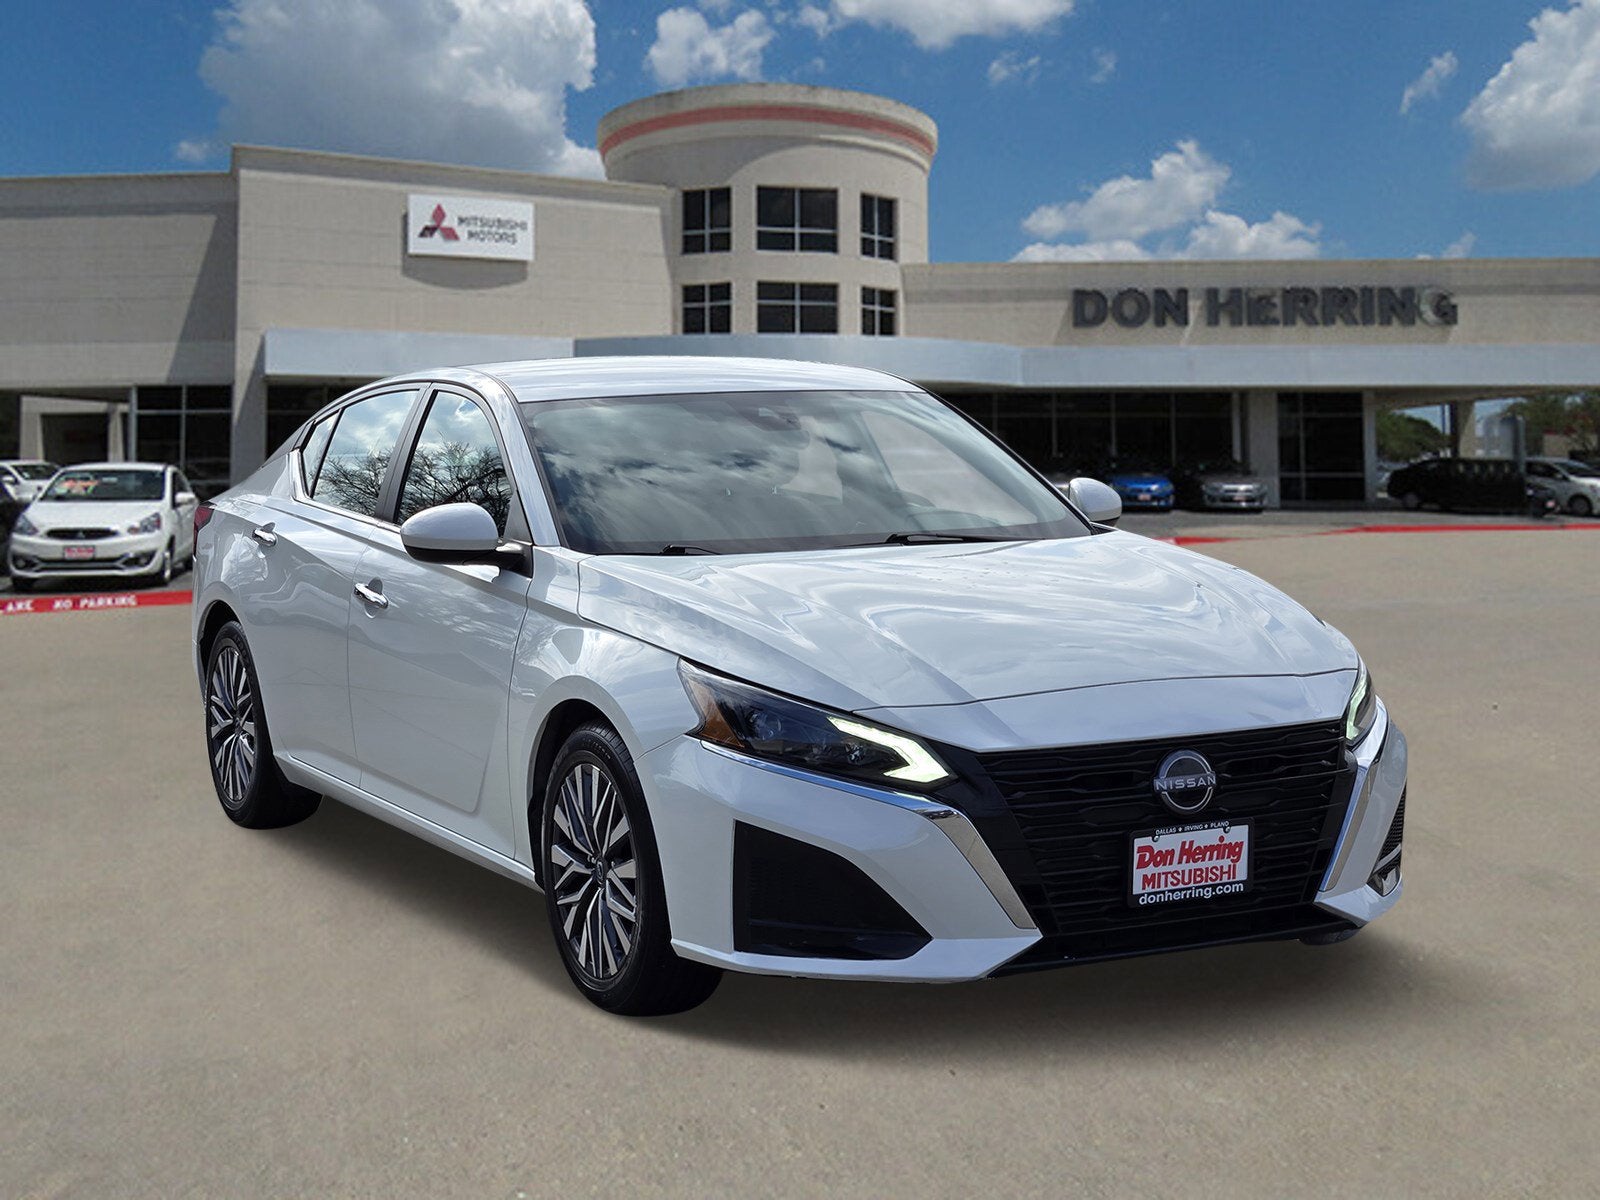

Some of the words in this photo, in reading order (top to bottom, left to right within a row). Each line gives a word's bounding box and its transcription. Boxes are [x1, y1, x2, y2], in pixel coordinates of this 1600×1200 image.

[458, 216, 528, 231] MITSUBISHI
[468, 230, 517, 244] MOTORS
[1072, 288, 1189, 328] DON
[1205, 286, 1459, 328] HERRING
[79, 594, 137, 609] PARKING
[1156, 775, 1217, 790] NISSAN
[1155, 827, 1177, 835] DALLAS
[1183, 824, 1204, 832] IRVING
[1136, 845, 1175, 869] Don
[1178, 835, 1244, 863] Herring
[1142, 863, 1237, 891] MITSUBISHI
[1138, 882, 1244, 905] donherring.com
